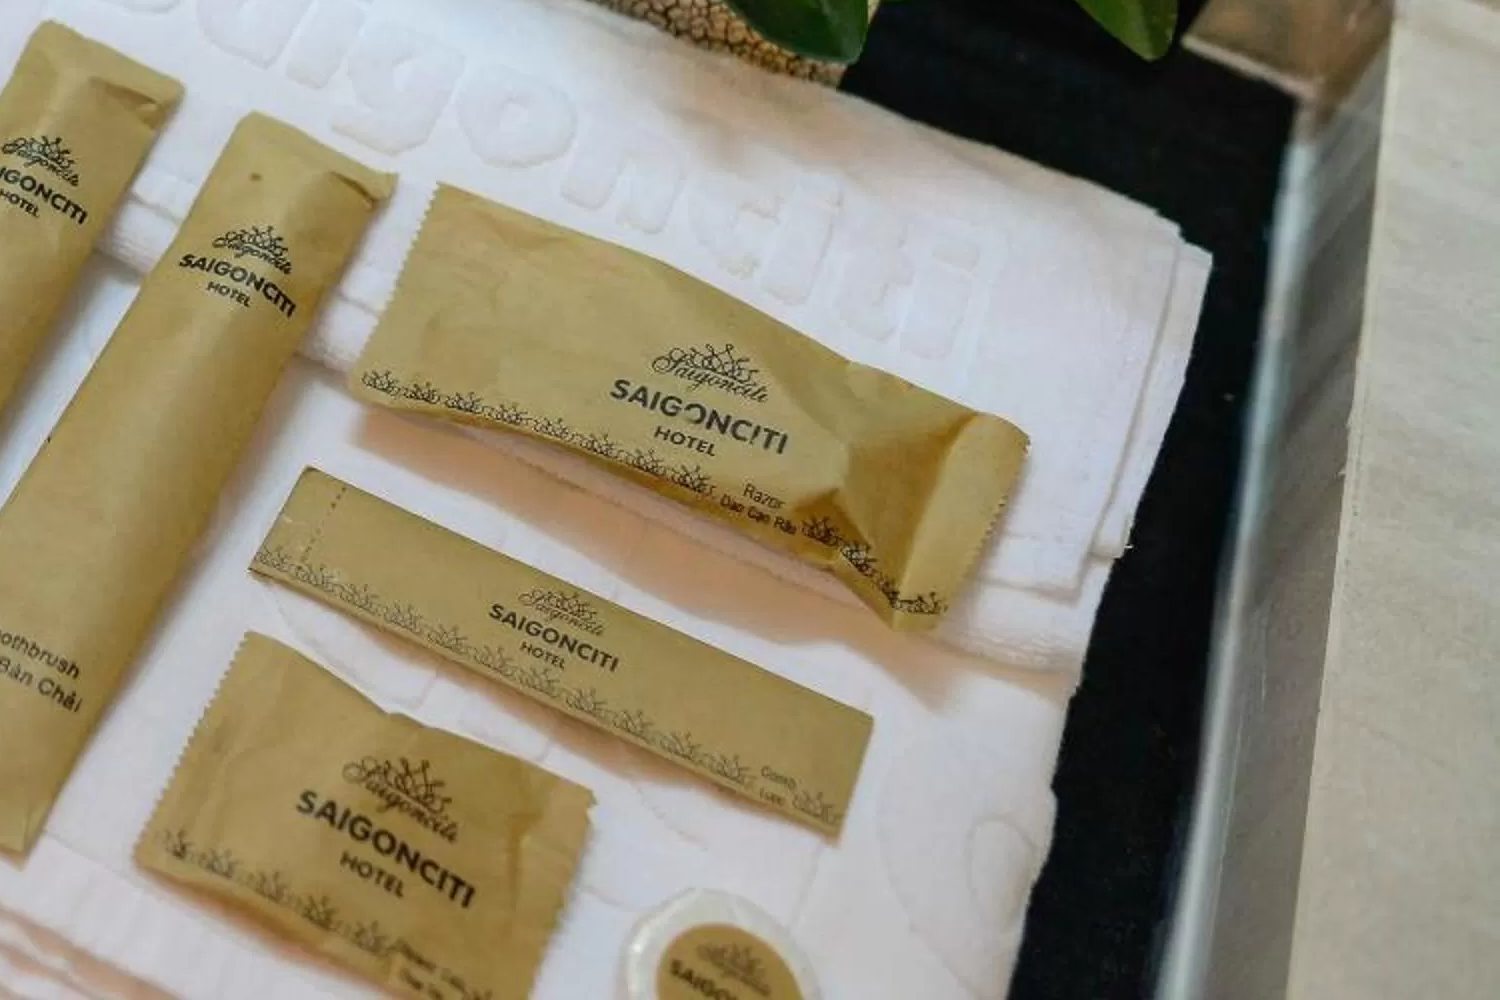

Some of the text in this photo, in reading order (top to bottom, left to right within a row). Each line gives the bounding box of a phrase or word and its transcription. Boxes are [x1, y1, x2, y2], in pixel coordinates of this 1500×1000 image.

[178, 253, 297, 319] SAIGONCITI
[206, 280, 251, 308] HOTEL
[609, 378, 790, 456] SAIGONCITI
[654, 425, 717, 458] HOTEL
[487, 602, 621, 673] SAIGONCITI
[520, 641, 566, 670] HOTEL
[295, 788, 477, 911] SAIGONCITI
[339, 850, 405, 899] HOTEL
[668, 957, 740, 1000] SAIGO
